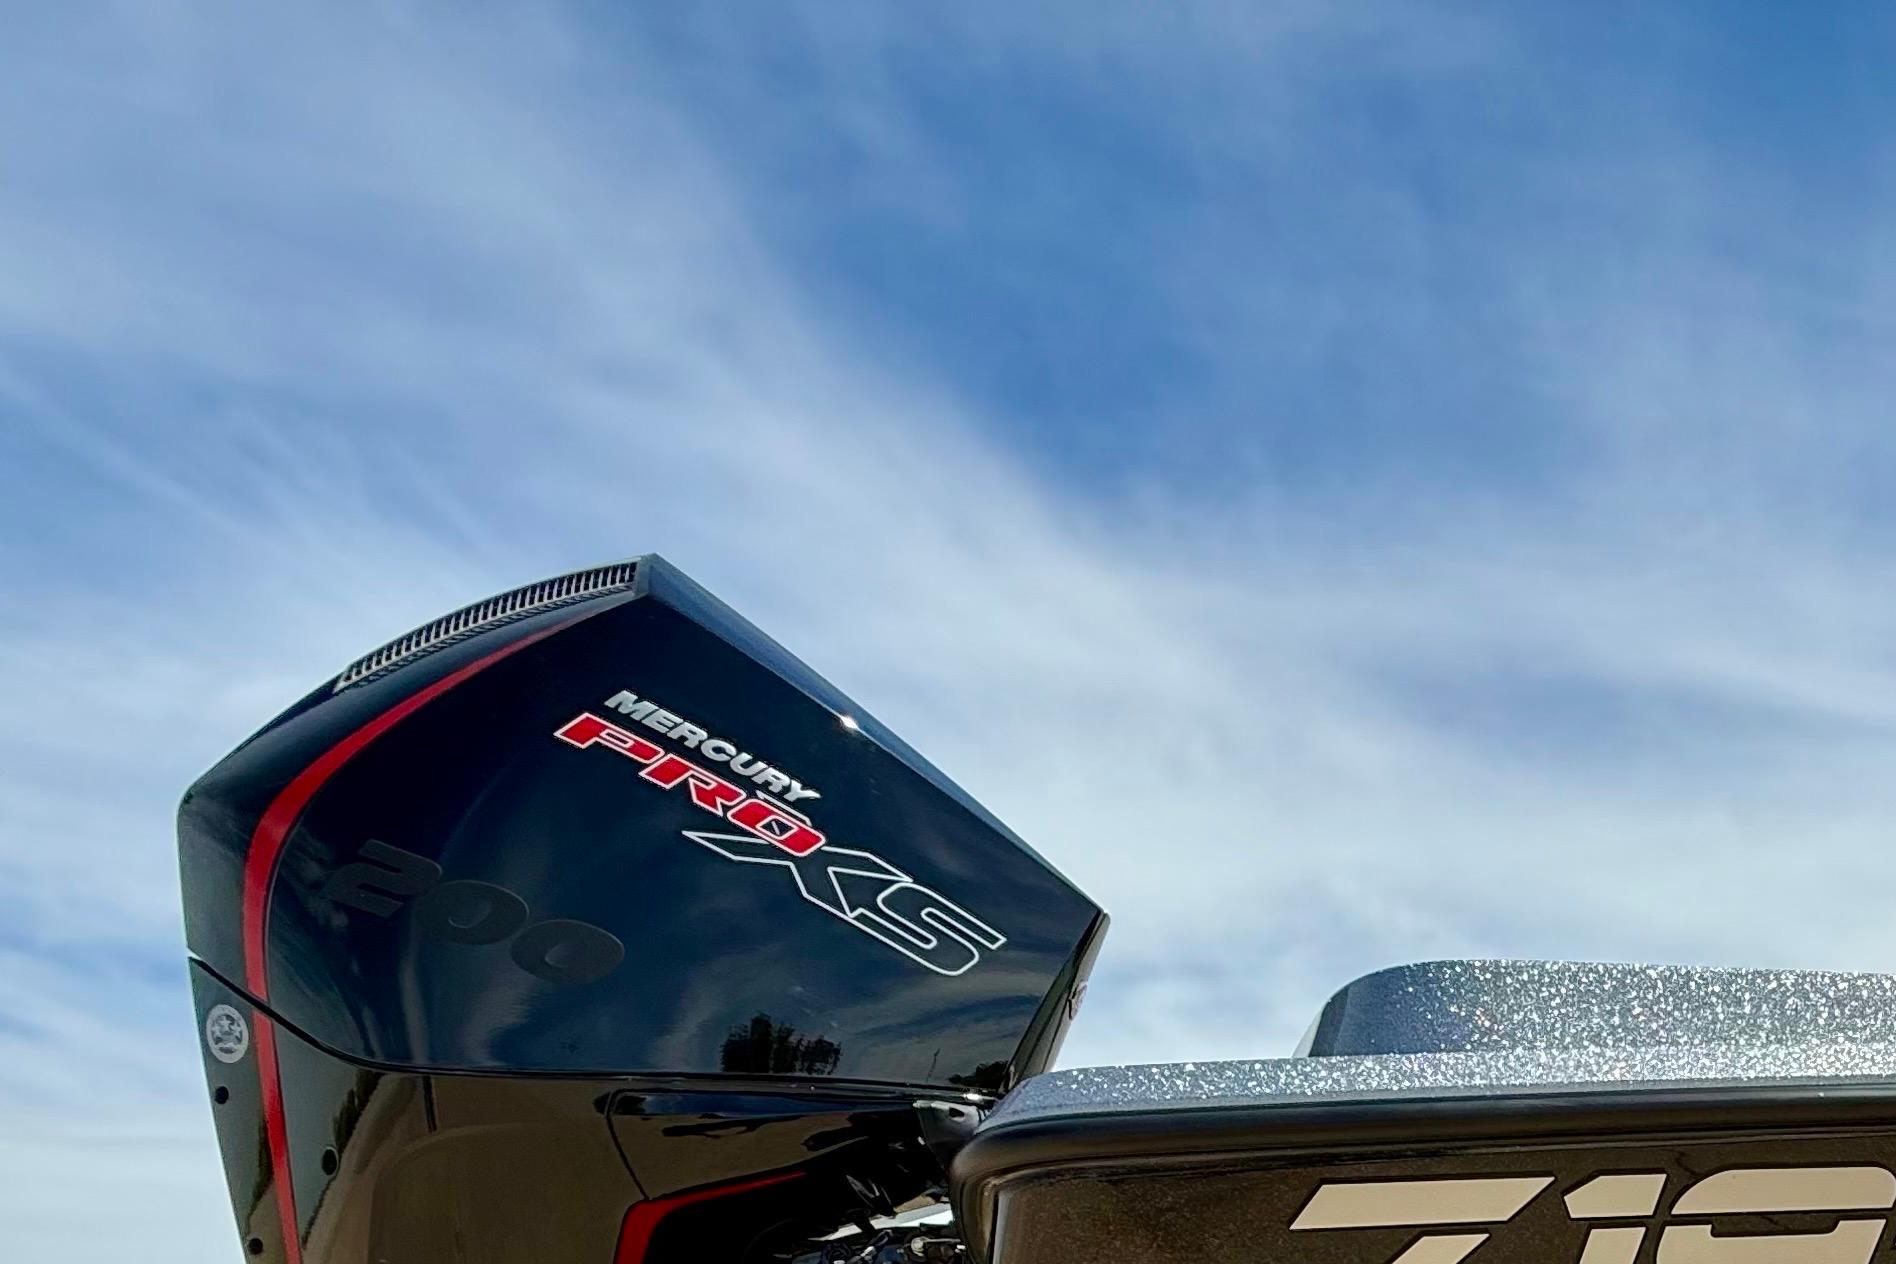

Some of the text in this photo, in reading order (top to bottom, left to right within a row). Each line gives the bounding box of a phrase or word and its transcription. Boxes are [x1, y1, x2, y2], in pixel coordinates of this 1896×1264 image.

[604, 690, 821, 803] MERCURY
[322, 839, 626, 985] 200
[554, 712, 1008, 977] PRO XS
